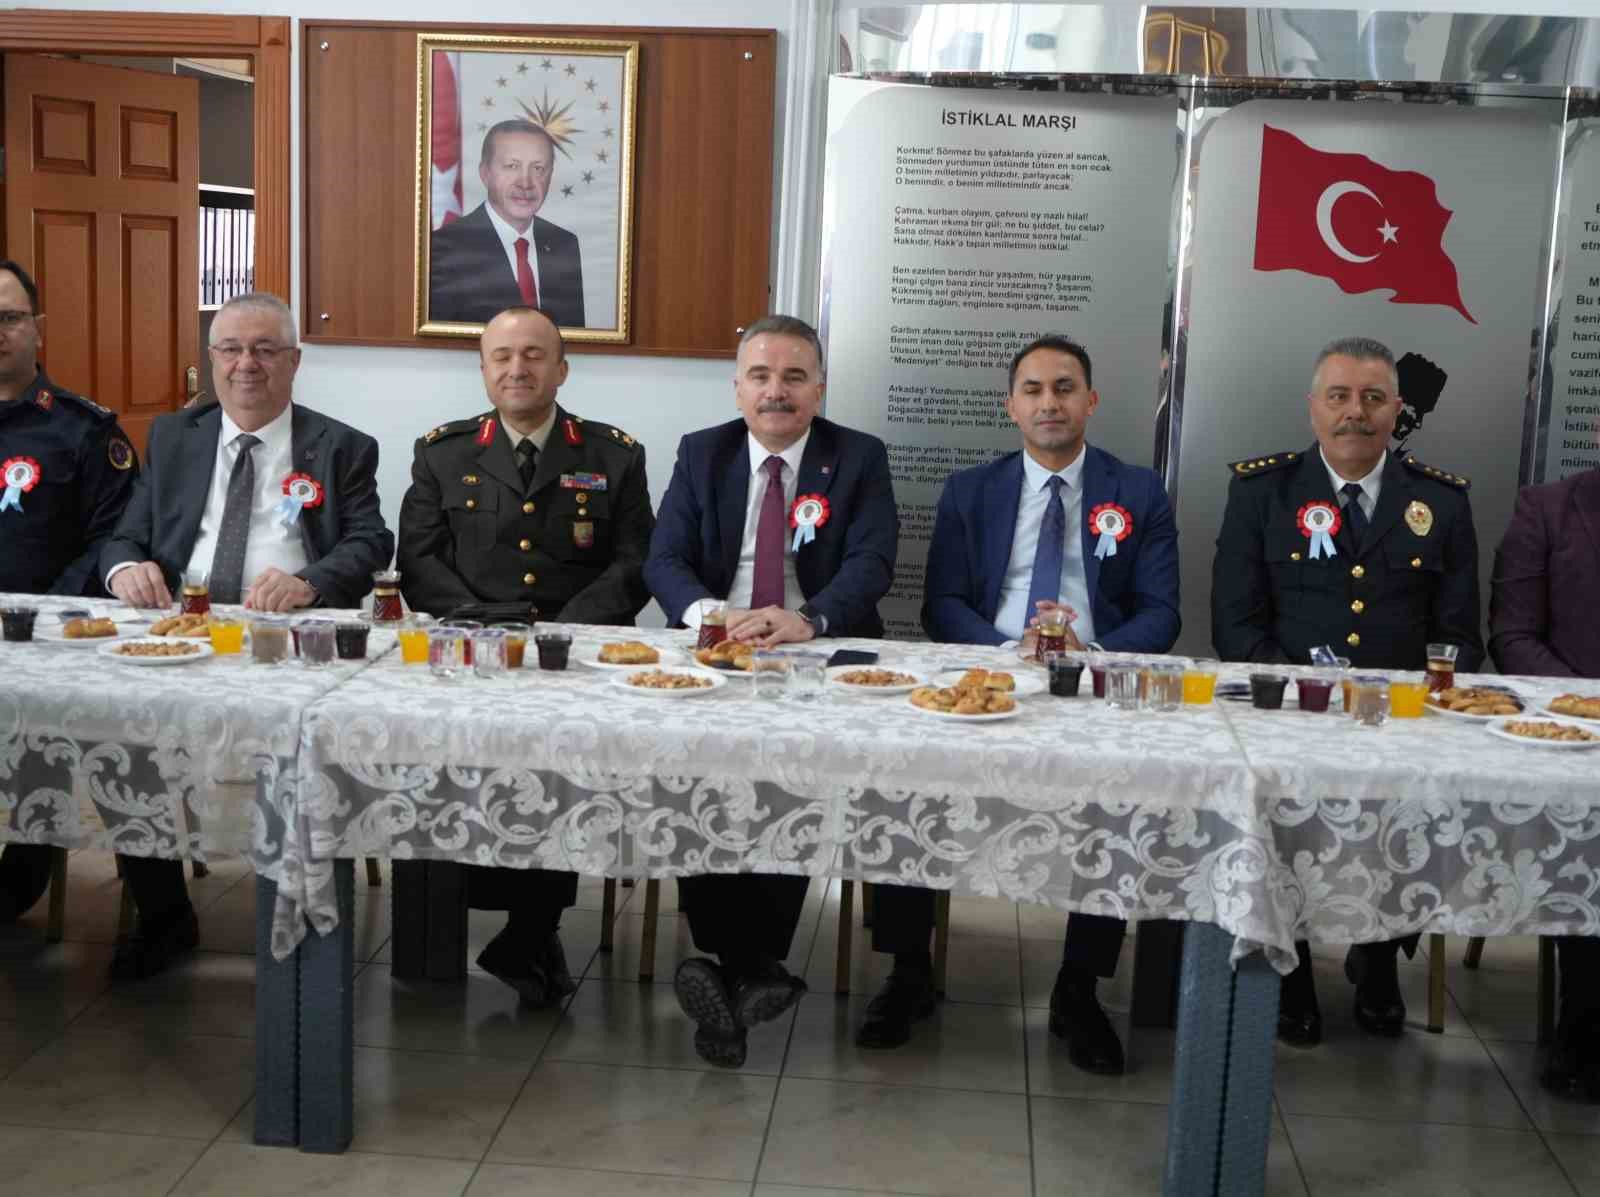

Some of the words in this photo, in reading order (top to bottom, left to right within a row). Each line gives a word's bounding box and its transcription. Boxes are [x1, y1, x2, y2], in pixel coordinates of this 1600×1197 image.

[942, 108, 1016, 127] İSTİKLAL
[1022, 114, 1076, 132] MARŞI
[896, 166, 903, 174] O
[1576, 296, 1593, 305] Bu
